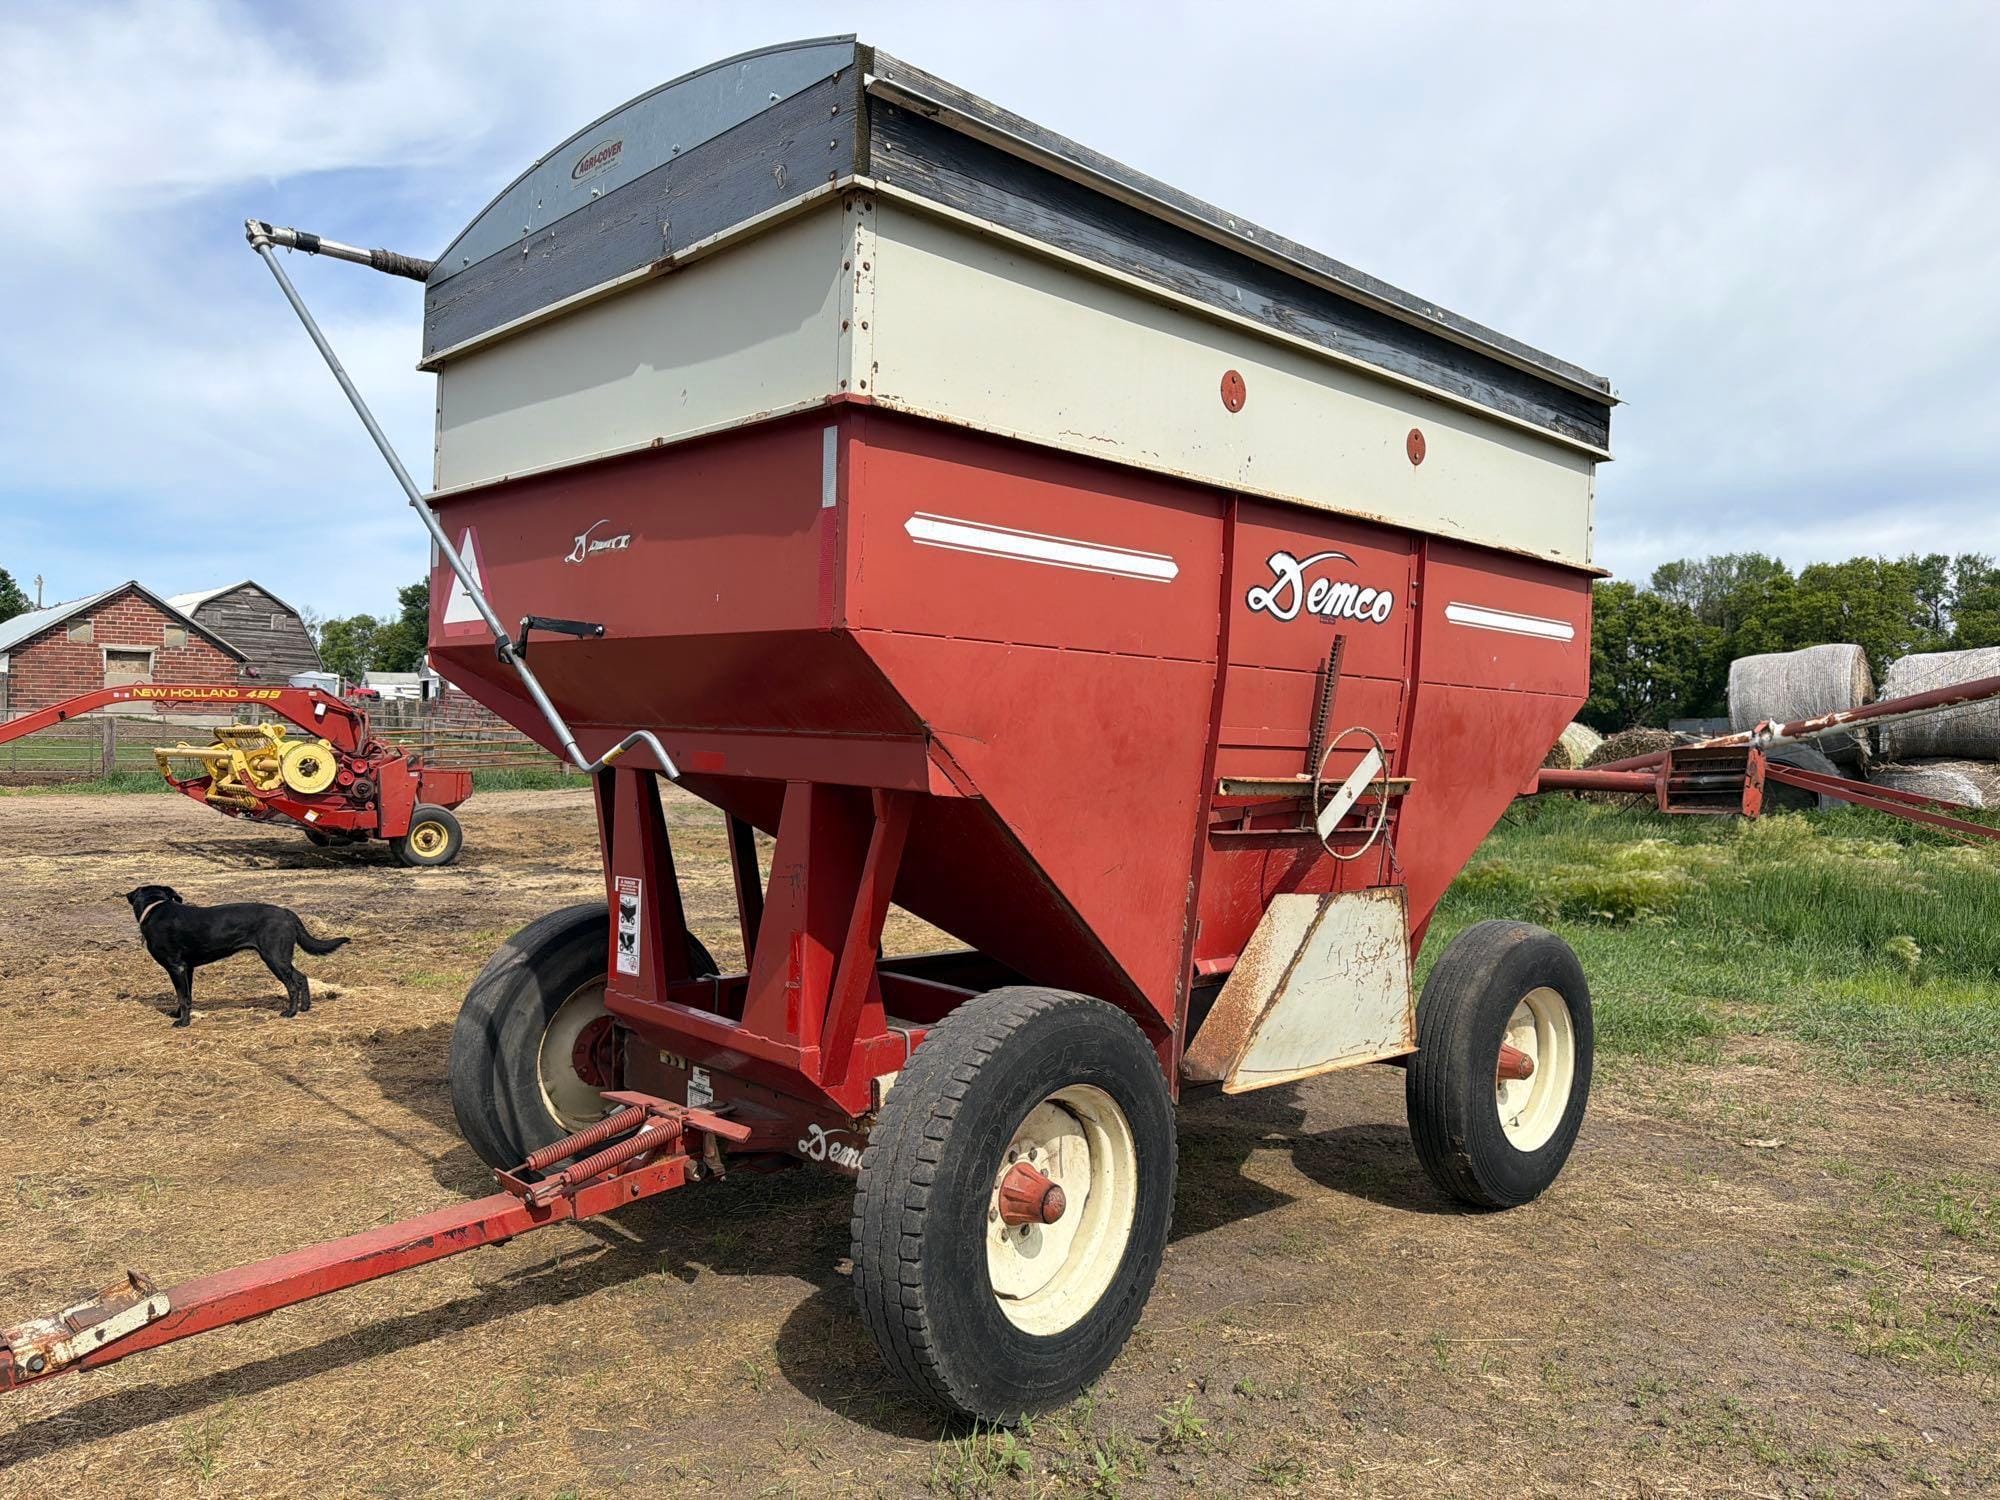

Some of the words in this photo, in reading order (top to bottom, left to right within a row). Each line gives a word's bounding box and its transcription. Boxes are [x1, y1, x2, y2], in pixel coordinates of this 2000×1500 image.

[578, 140, 624, 176] AGRI-COVER
[1245, 550, 1394, 625] Demco
[132, 688, 167, 697] NEW
[170, 688, 239, 698] HOLLAND
